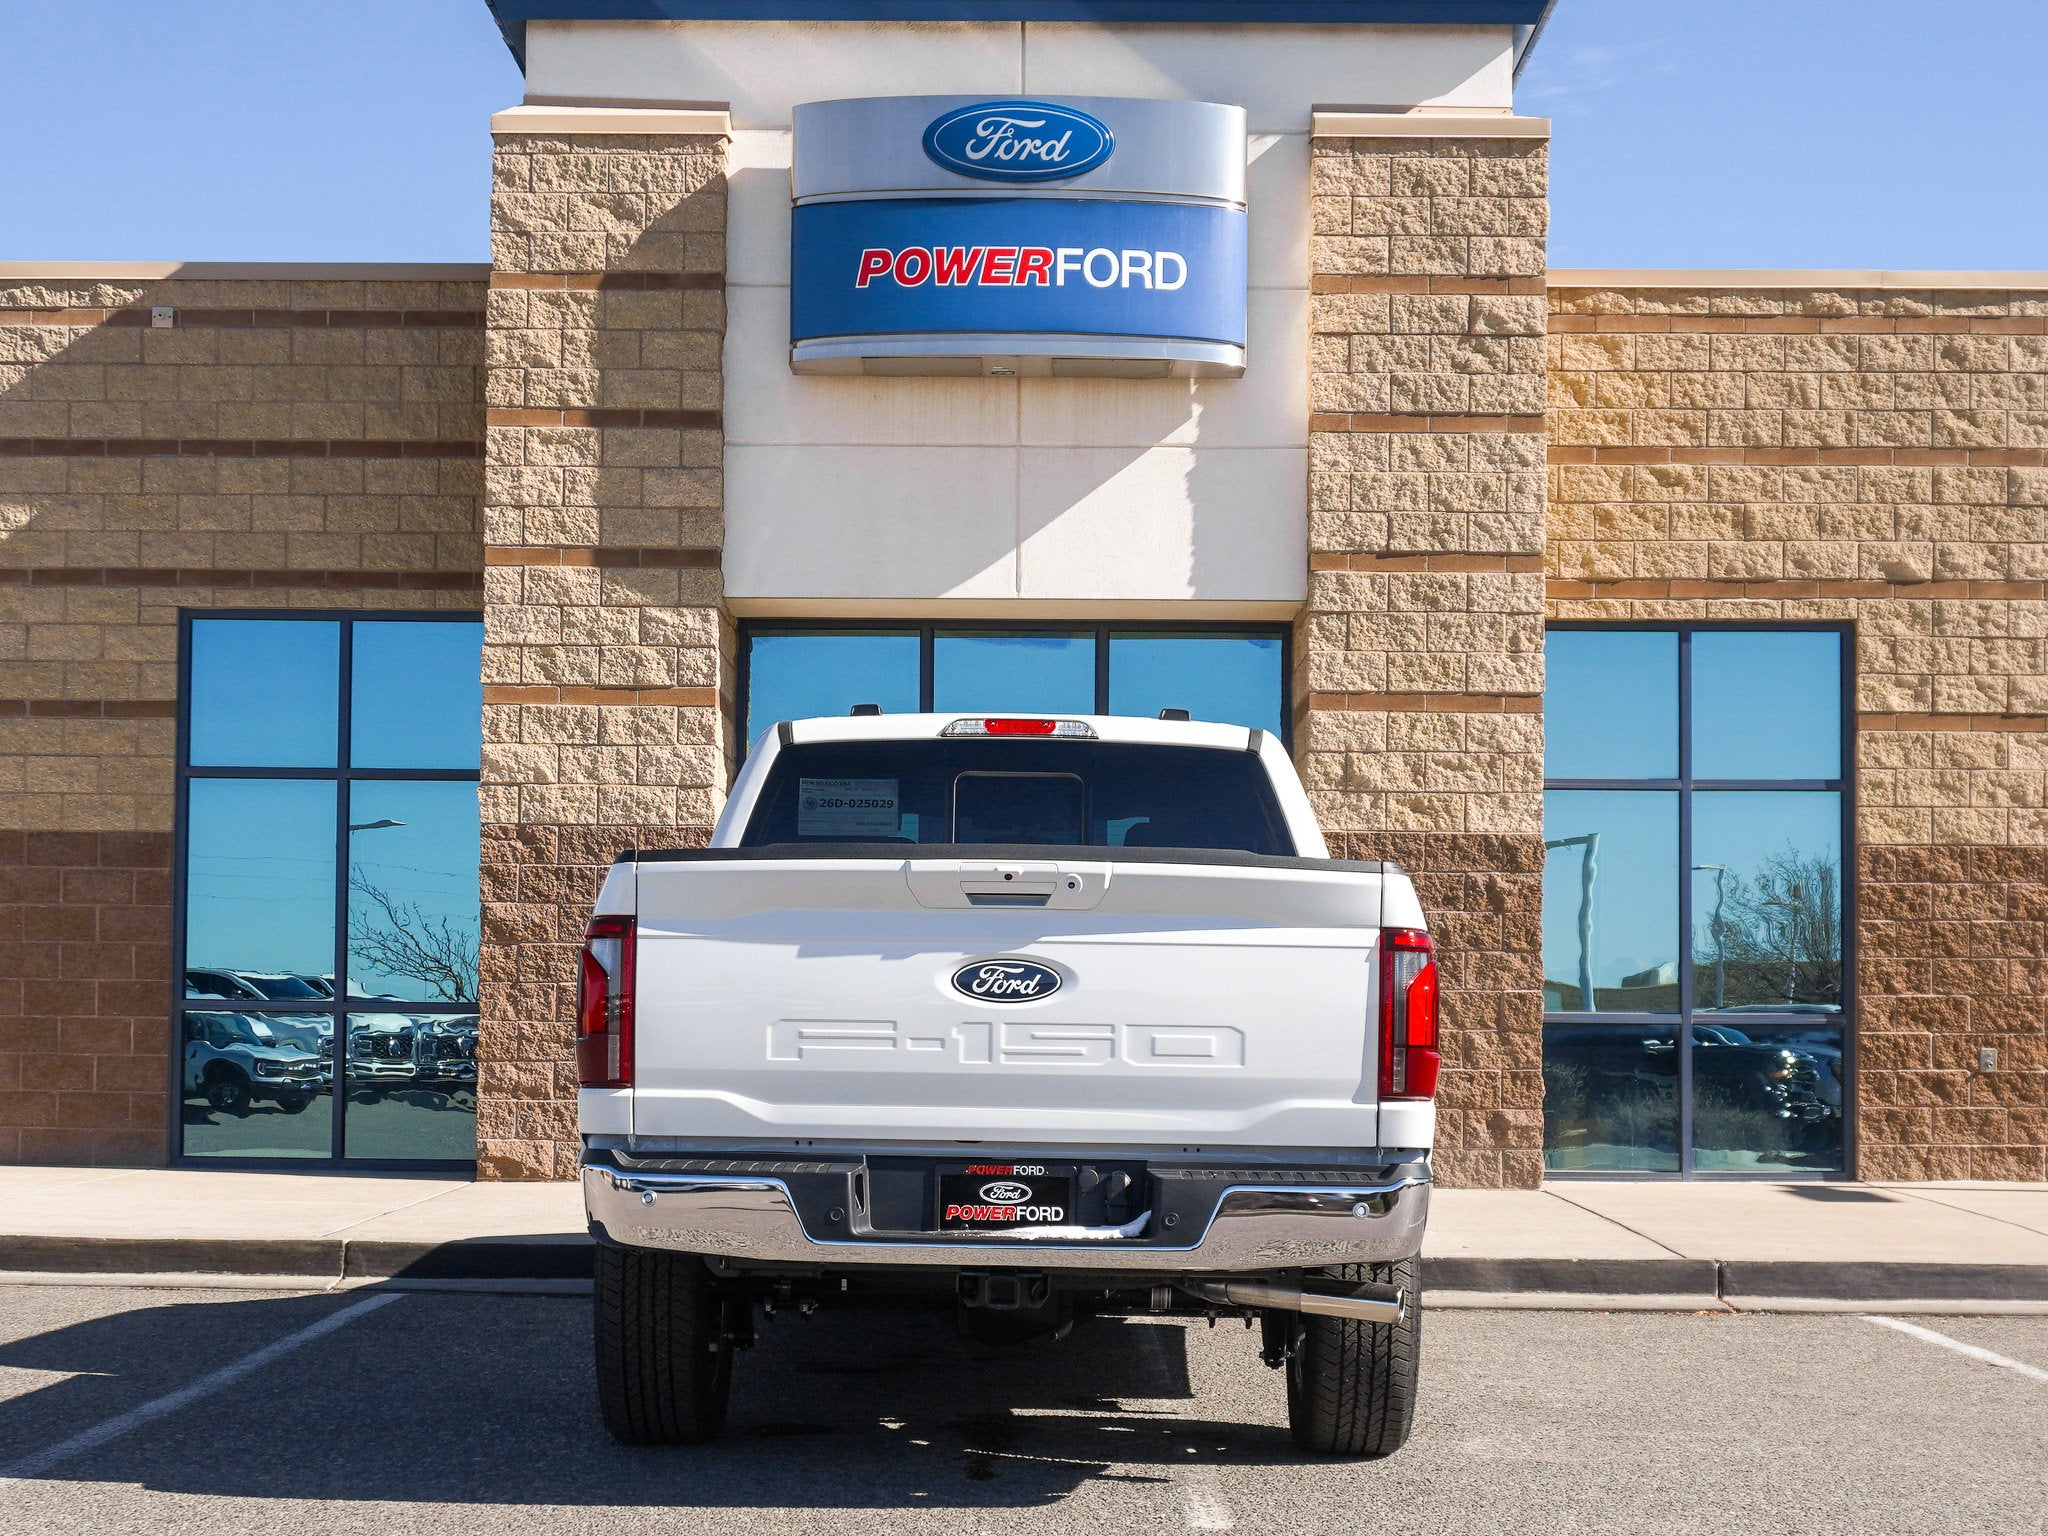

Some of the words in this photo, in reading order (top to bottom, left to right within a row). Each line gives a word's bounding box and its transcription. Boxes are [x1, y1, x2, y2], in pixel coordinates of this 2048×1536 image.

[965, 116, 1072, 162] Ford
[819, 798, 894, 809] 26D-025029
[972, 965, 1042, 996] Ford
[766, 1019, 1246, 1068] F-150
[989, 1185, 1022, 1200] Ford
